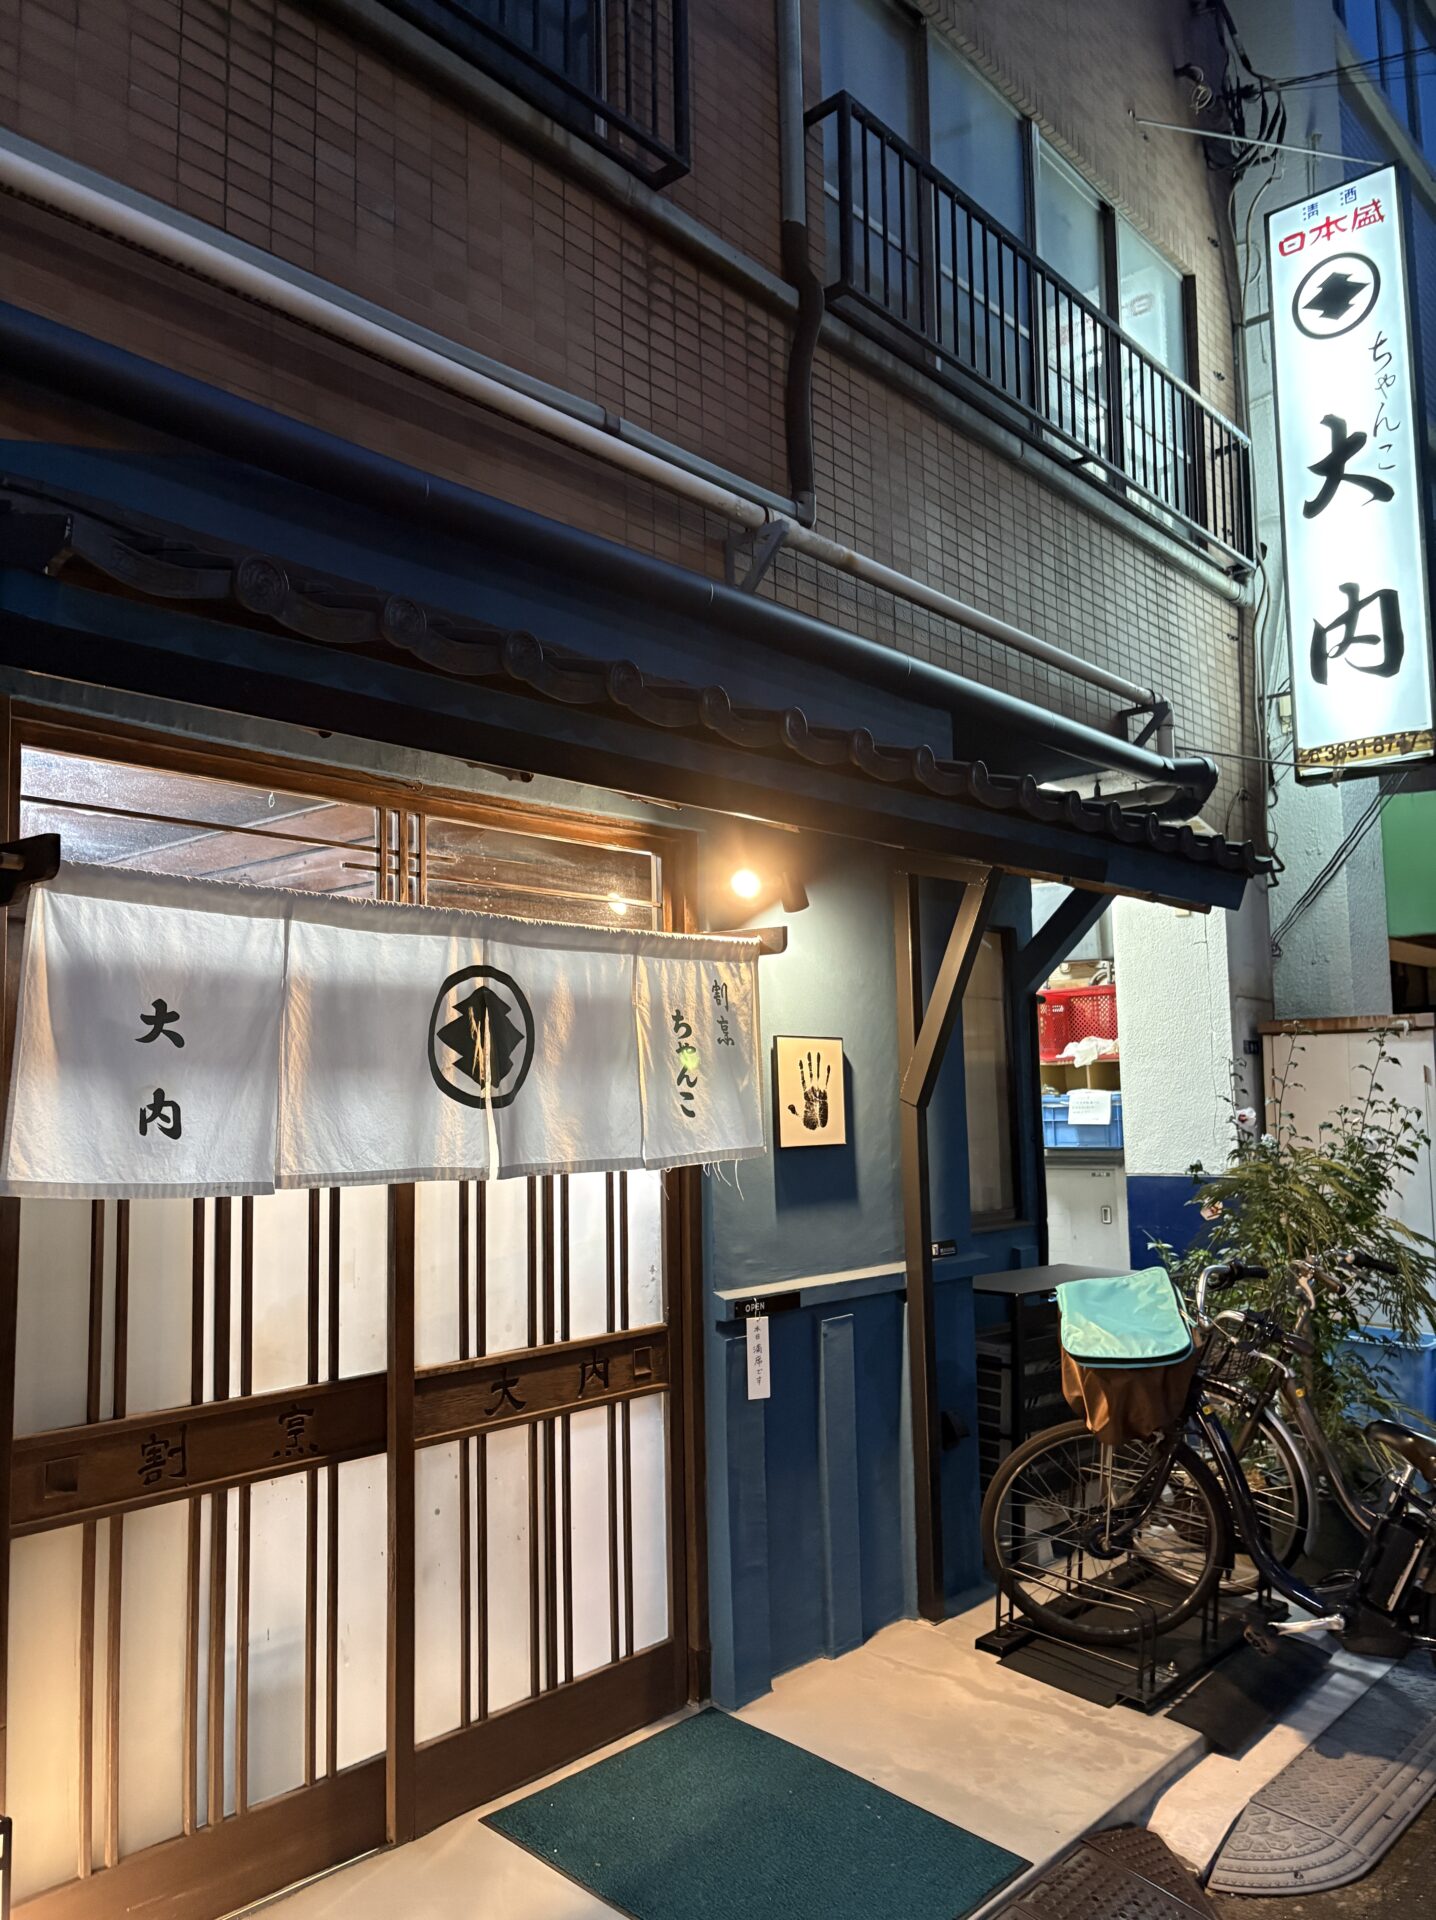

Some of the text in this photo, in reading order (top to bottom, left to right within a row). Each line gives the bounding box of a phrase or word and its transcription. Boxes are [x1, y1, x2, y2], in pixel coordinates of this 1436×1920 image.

[1278, 198, 1386, 256] 日本盛
[1303, 186, 1357, 221] 清酒
[1368, 331, 1400, 469] ちゃんこ
[1302, 413, 1405, 686] 大内
[134, 998, 185, 1140] 大内
[744, 1302, 766, 1313] OPEN
[483, 1347, 610, 1417] 大内
